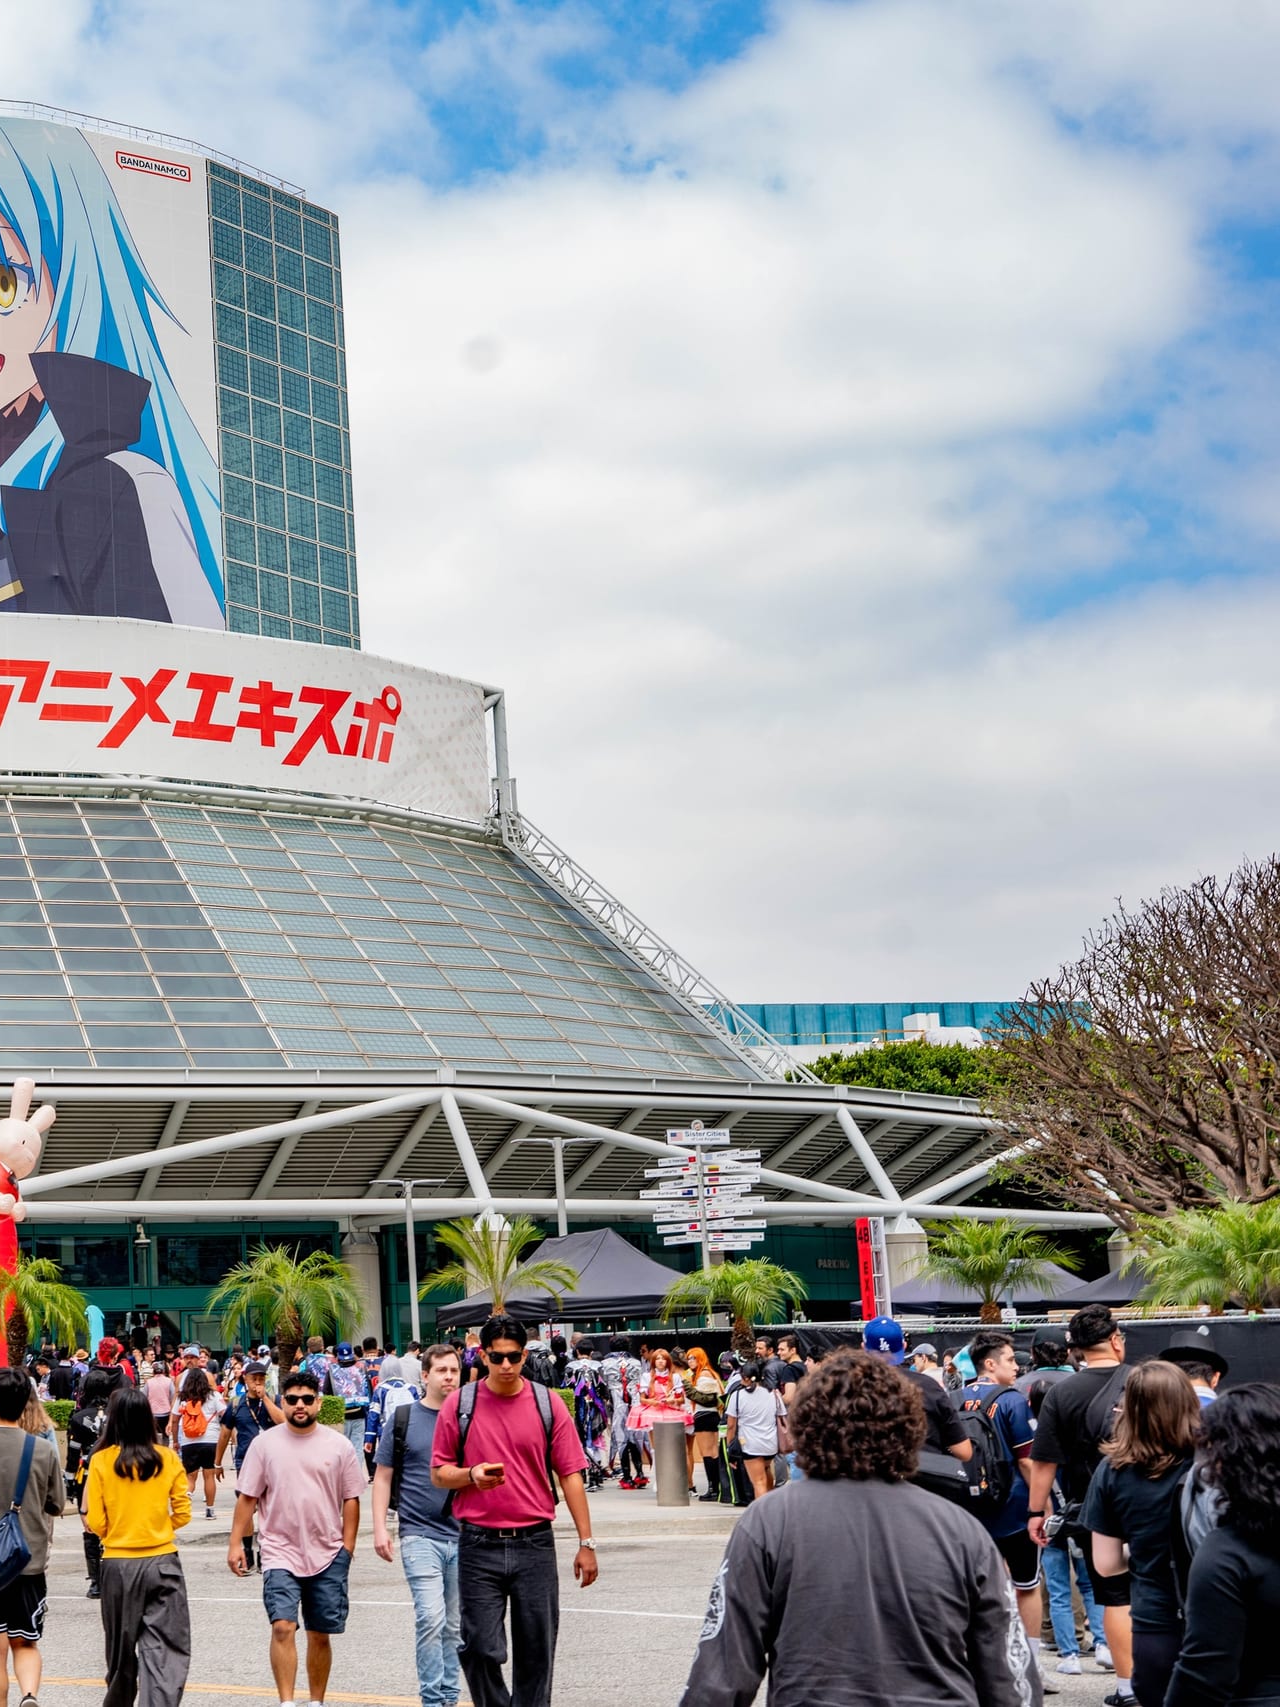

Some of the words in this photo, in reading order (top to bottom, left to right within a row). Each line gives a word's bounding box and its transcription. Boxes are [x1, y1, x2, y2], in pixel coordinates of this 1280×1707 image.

[120, 156, 153, 170] BANDAI
[154, 164, 187, 178] NAMCO
[858, 1227, 869, 1243] 4B
